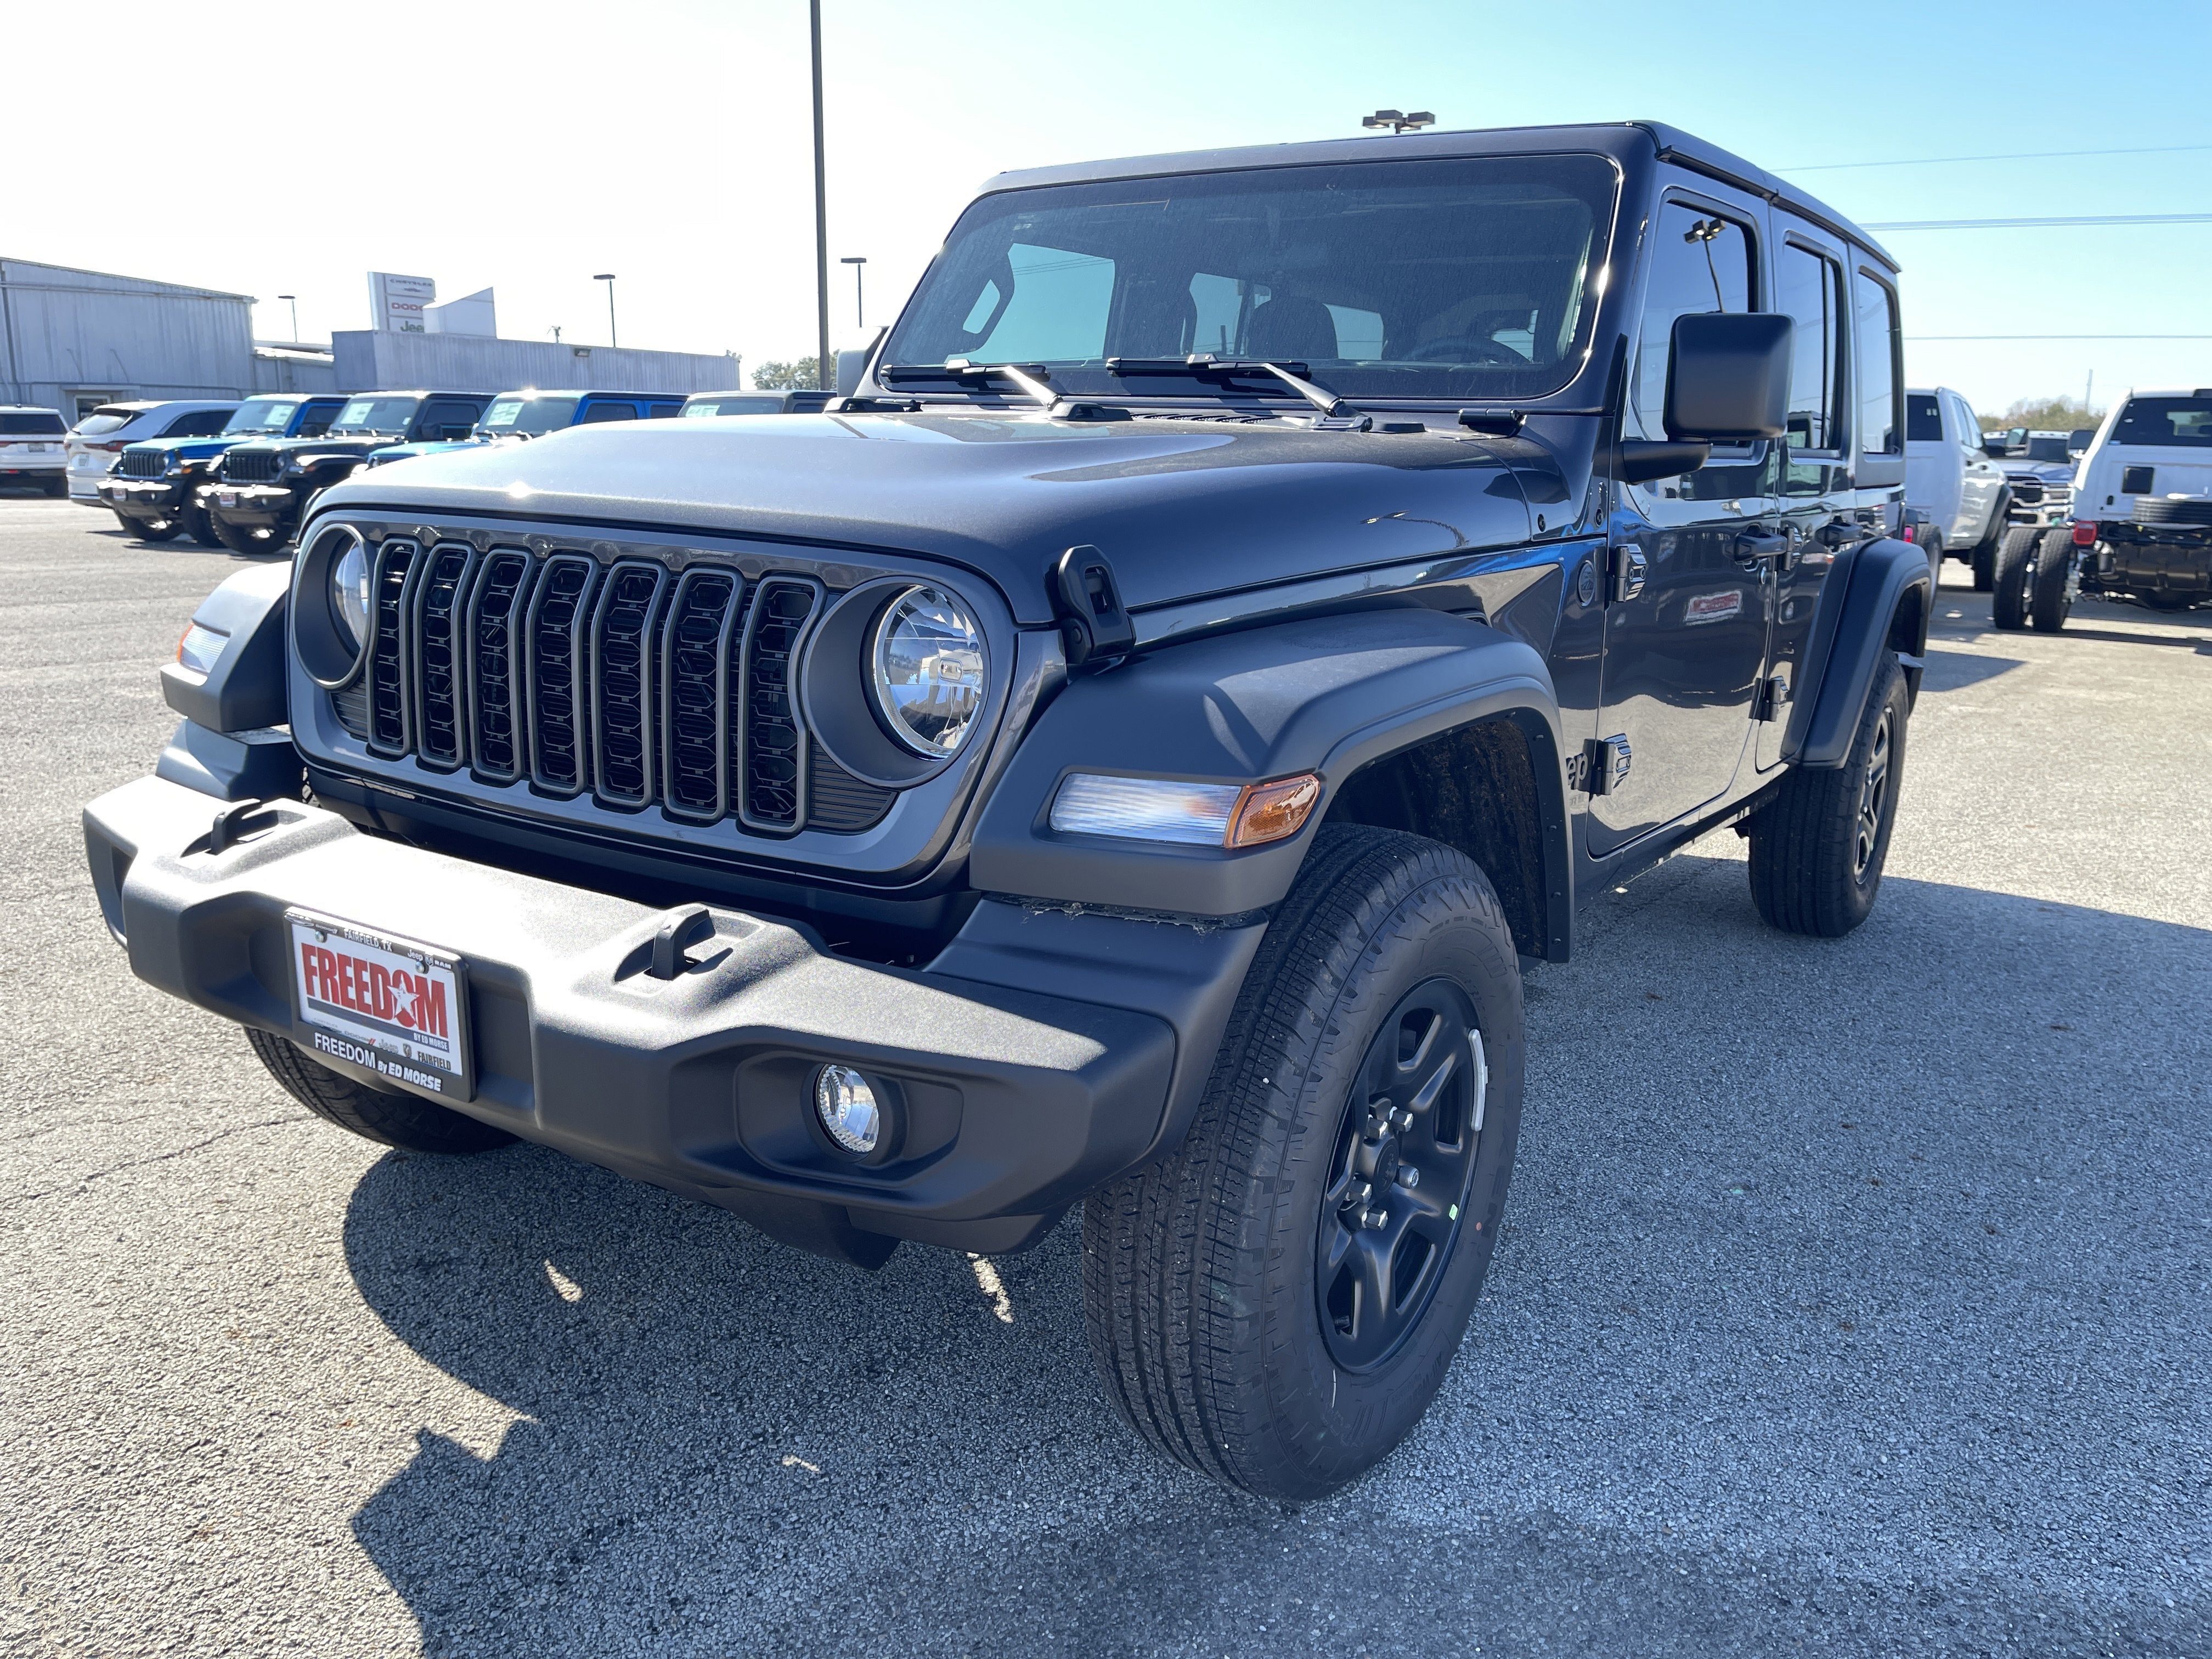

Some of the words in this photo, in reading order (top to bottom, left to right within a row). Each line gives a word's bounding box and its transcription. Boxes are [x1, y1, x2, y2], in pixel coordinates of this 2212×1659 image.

[391, 302, 422, 311] DOD
[400, 320, 425, 334] Jee
[1566, 753, 1588, 790] ep
[382, 939, 392, 952] TX
[407, 949, 424, 962] Jeep
[301, 943, 449, 1039] FREEDOM
[413, 1032, 421, 1042] BY
[421, 1035, 428, 1044] ED
[429, 1037, 448, 1050] MORSE
[314, 1032, 376, 1069] FREEDOM
[388, 1062, 403, 1078] ED
[403, 1066, 442, 1092] MORSE
[417, 1051, 452, 1070] FAIRFIELD
